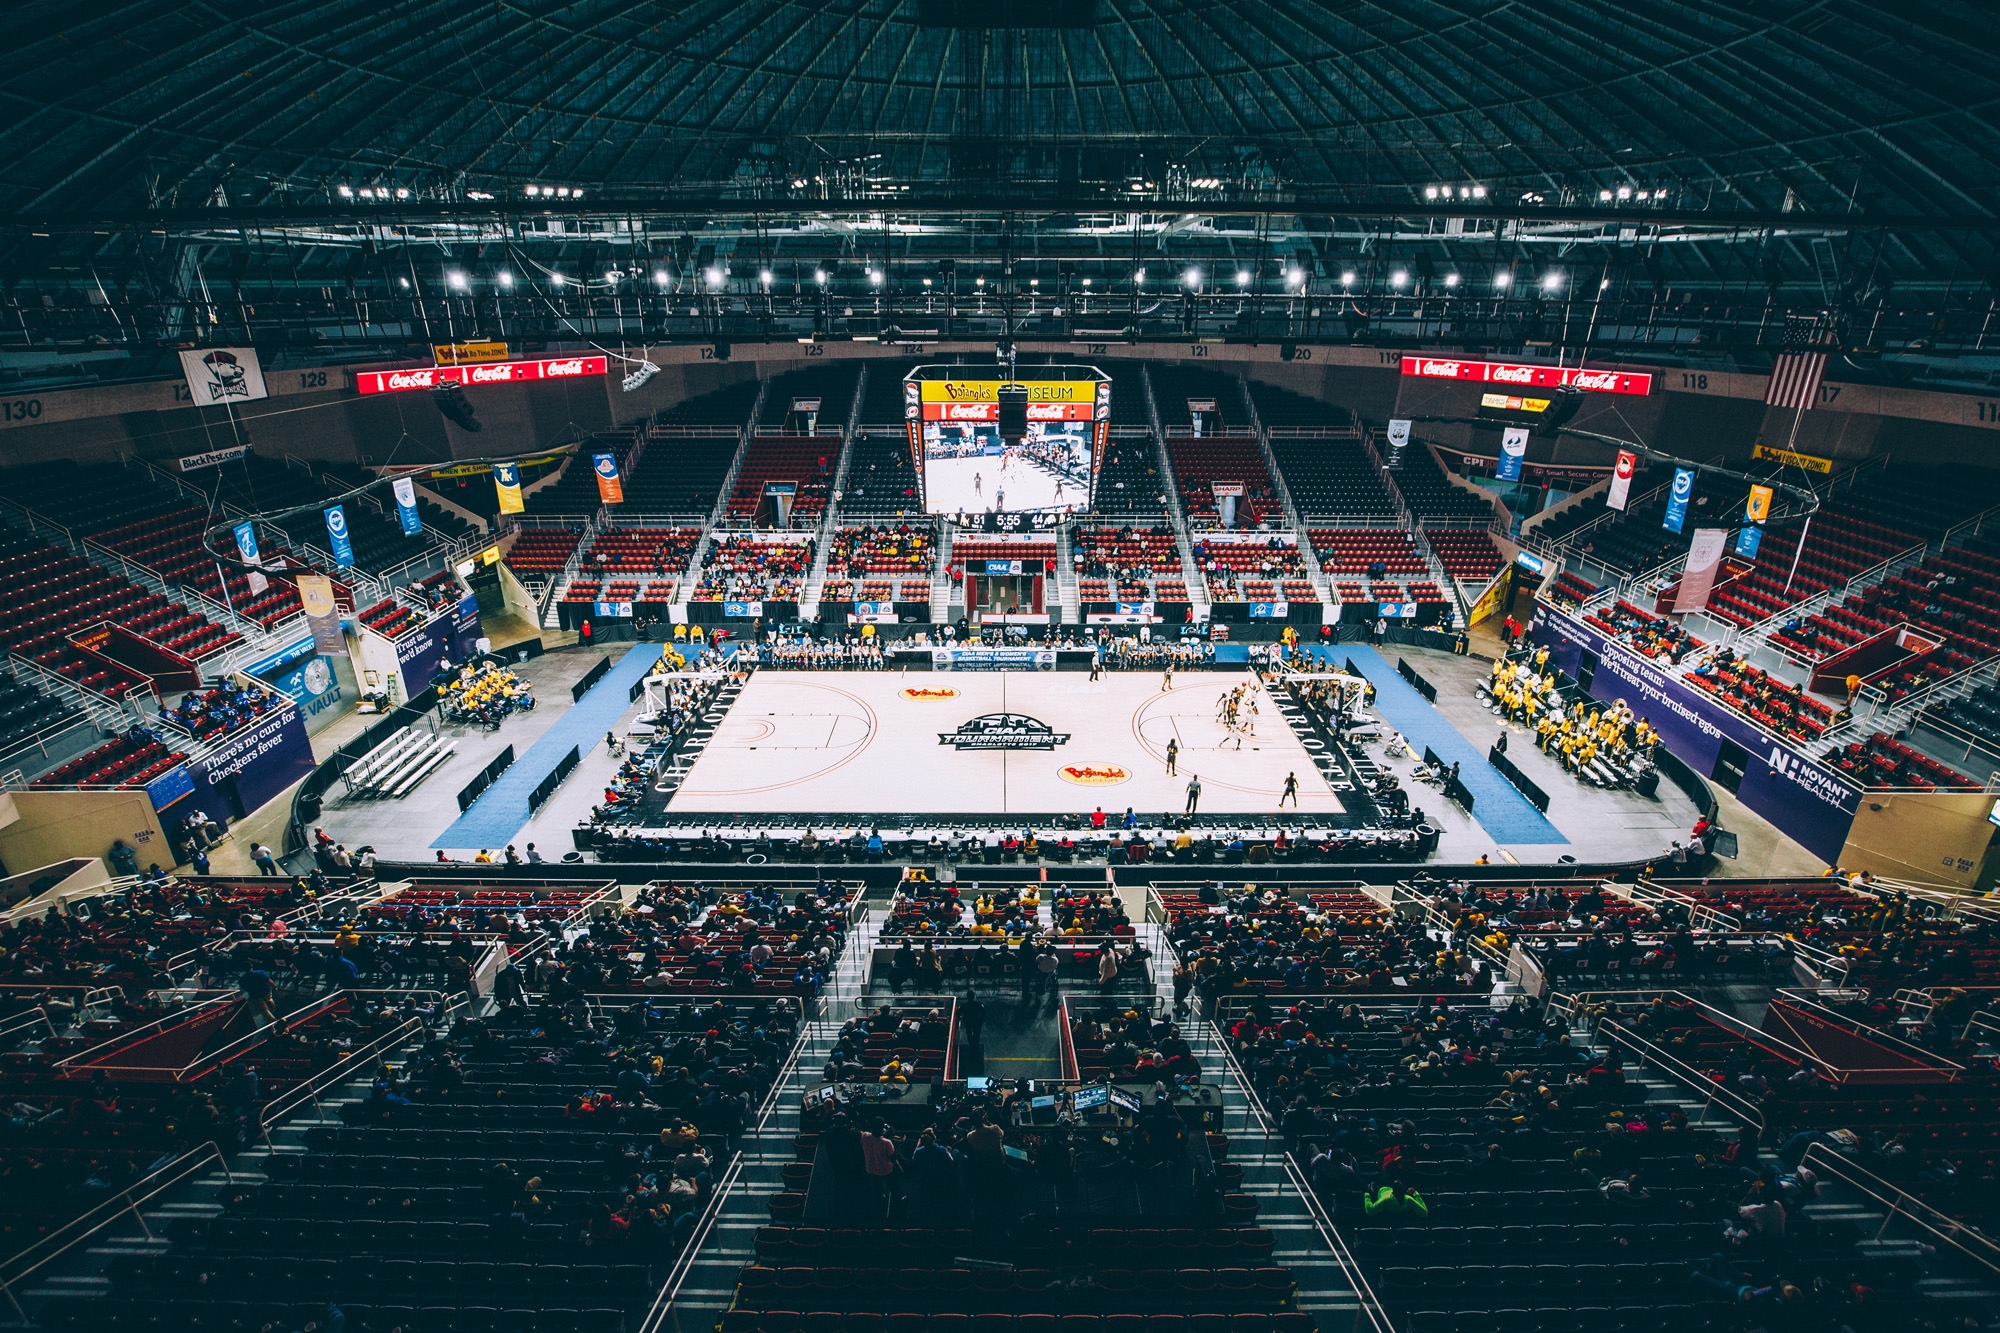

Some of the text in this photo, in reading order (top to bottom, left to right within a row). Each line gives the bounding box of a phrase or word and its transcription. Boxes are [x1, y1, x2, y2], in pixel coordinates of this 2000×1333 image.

[804, 345, 824, 356] 125
[1088, 344, 1107, 354] 122
[1191, 346, 1208, 357] 121
[1295, 348, 1311, 360] 20
[300, 371, 327, 388] 128
[1682, 373, 1708, 389] 118
[2, 399, 42, 421] 130
[181, 449, 243, 469] BlackPest.com
[973, 514, 986, 525] 51
[996, 515, 1021, 526] 5:55
[1031, 514, 1044, 524] 44
[290, 642, 316, 659] THE VAULT
[396, 632, 427, 654] Trust us,
[399, 638, 433, 664] we'd know
[1602, 642, 1666, 688] Opposing team:
[308, 687, 342, 716] VAULT
[1600, 653, 1721, 739] We'll treat your bruised egos
[203, 742, 244, 772] There's
[244, 734, 259, 748] no
[259, 721, 281, 739] cure
[281, 711, 296, 726] for
[944, 735, 1066, 743] TOURNAMENT
[208, 749, 258, 785] Checkers
[258, 733, 283, 755] fever
[1796, 774, 1841, 808] HEALTH
[1800, 764, 1850, 800] NOVANT
